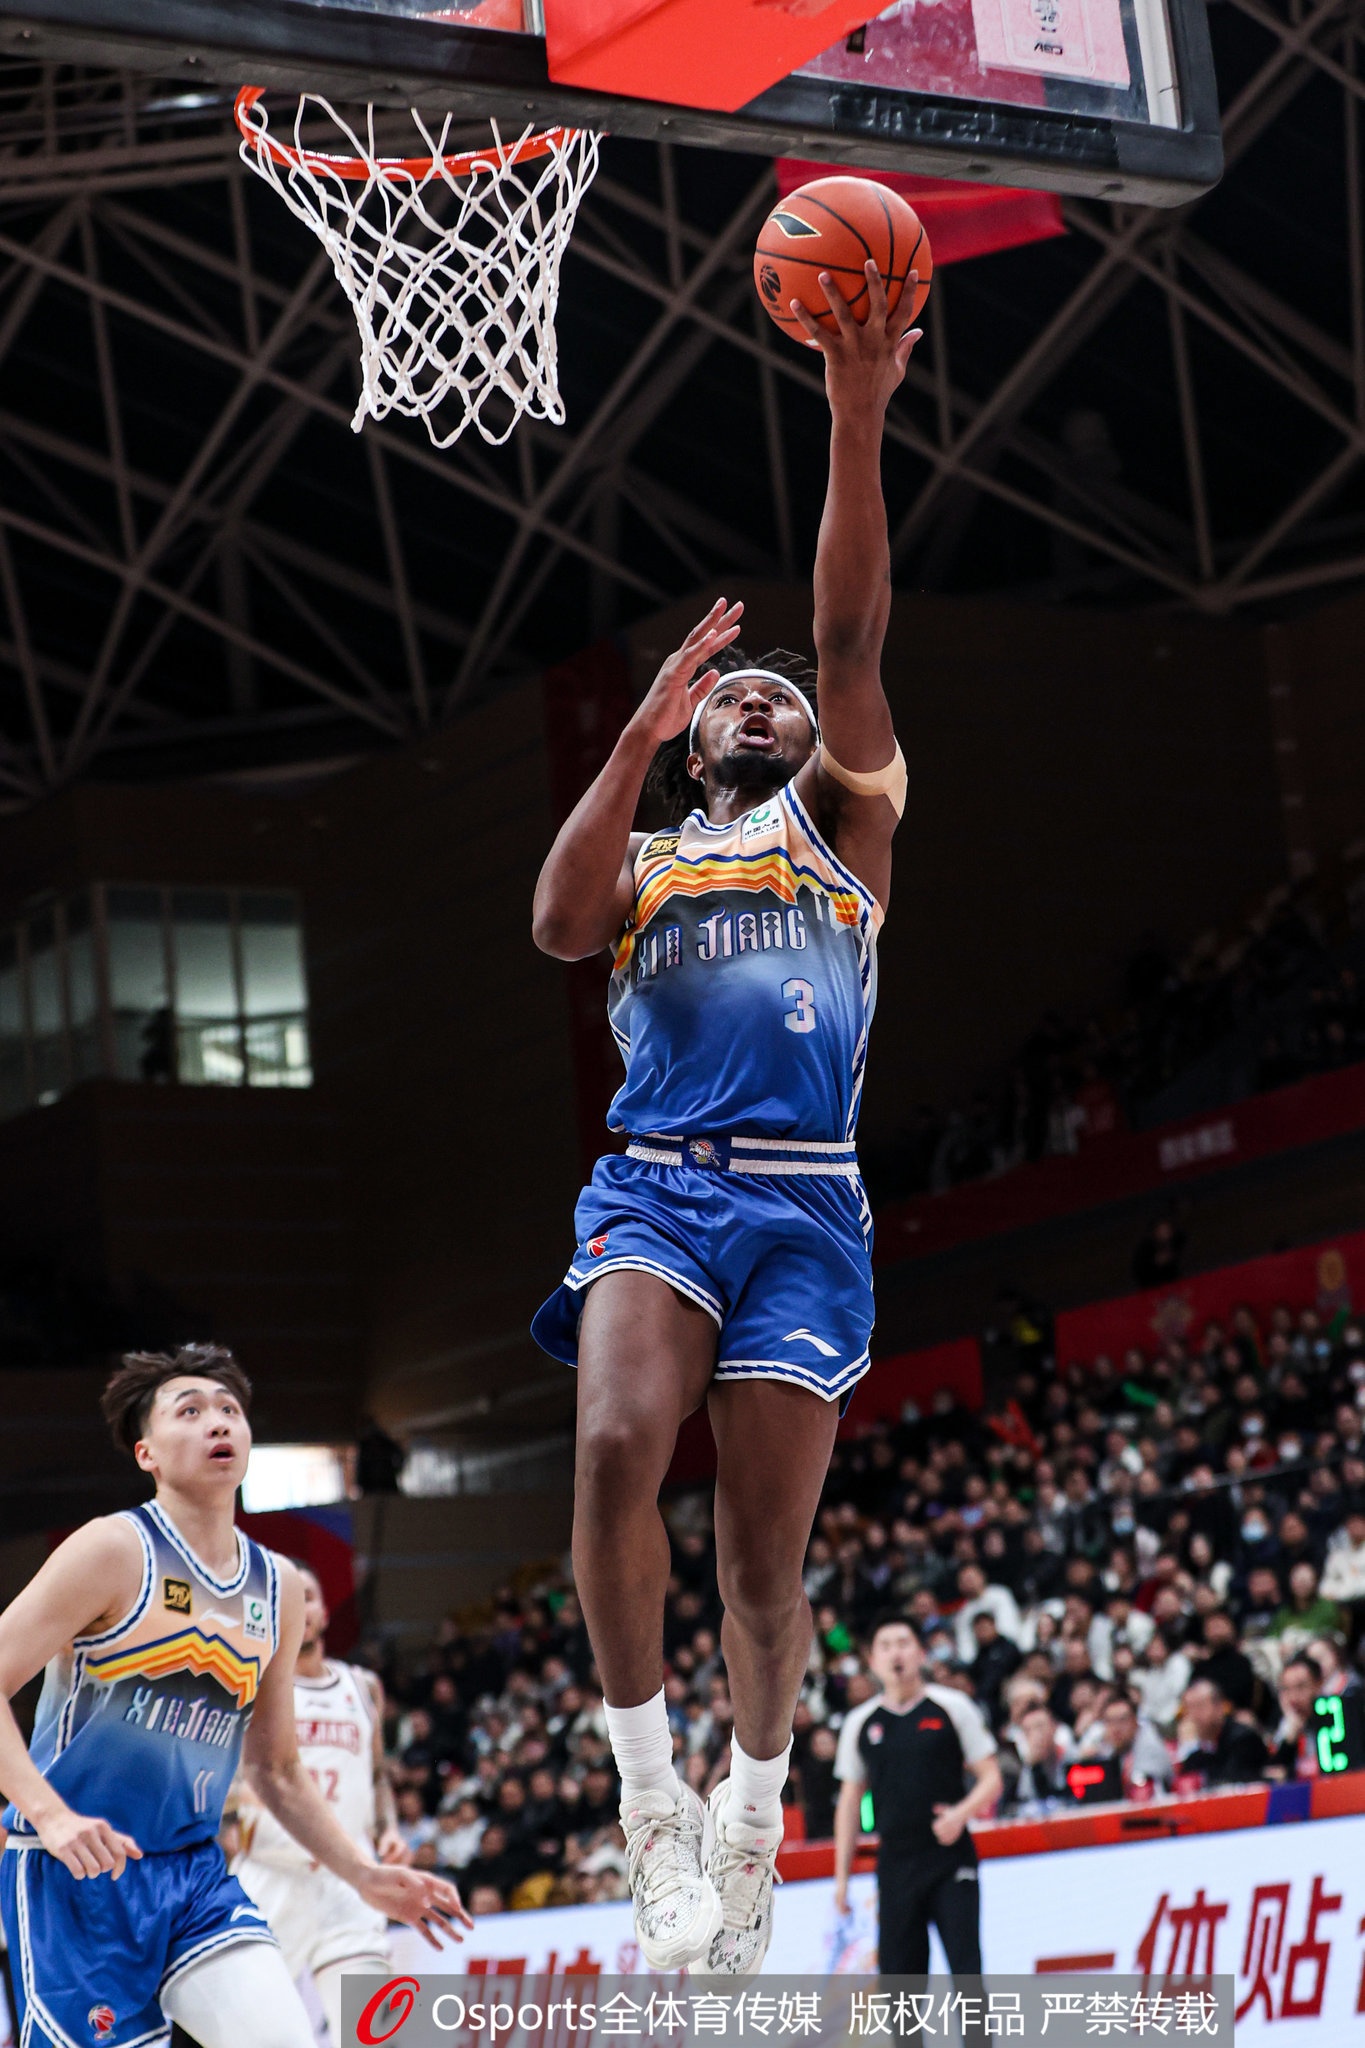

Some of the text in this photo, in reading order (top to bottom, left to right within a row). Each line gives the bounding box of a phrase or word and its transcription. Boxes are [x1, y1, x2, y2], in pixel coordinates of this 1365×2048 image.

[781, 978, 816, 1033] 3
[1315, 1696, 1348, 1772] 2
[193, 1769, 214, 1813] 11
[1035, 1874, 1365, 2036] 一体贴
